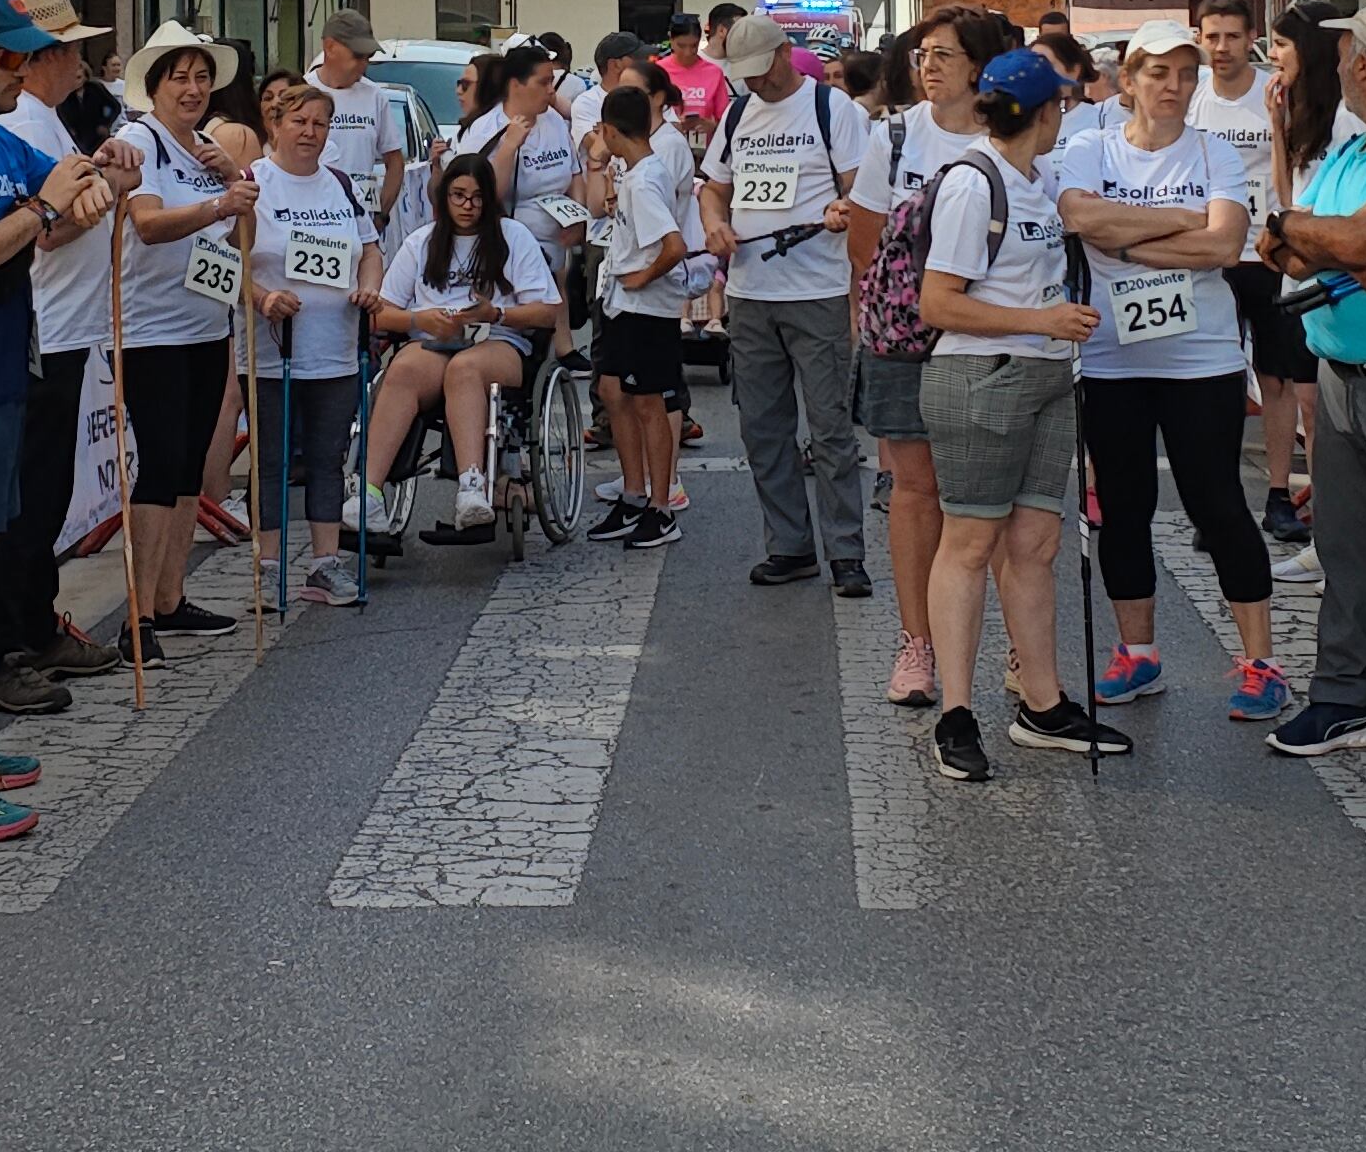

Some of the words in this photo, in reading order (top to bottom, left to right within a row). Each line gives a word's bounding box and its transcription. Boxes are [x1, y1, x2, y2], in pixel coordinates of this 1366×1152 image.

[749, 132, 815, 148] solidaria
[903, 171, 924, 190] La
[1118, 181, 1204, 200] solidaria
[740, 180, 788, 203] 232
[1018, 221, 1045, 241] La
[293, 250, 341, 280] 233
[192, 258, 236, 294] 235
[1124, 293, 1188, 333] 254
